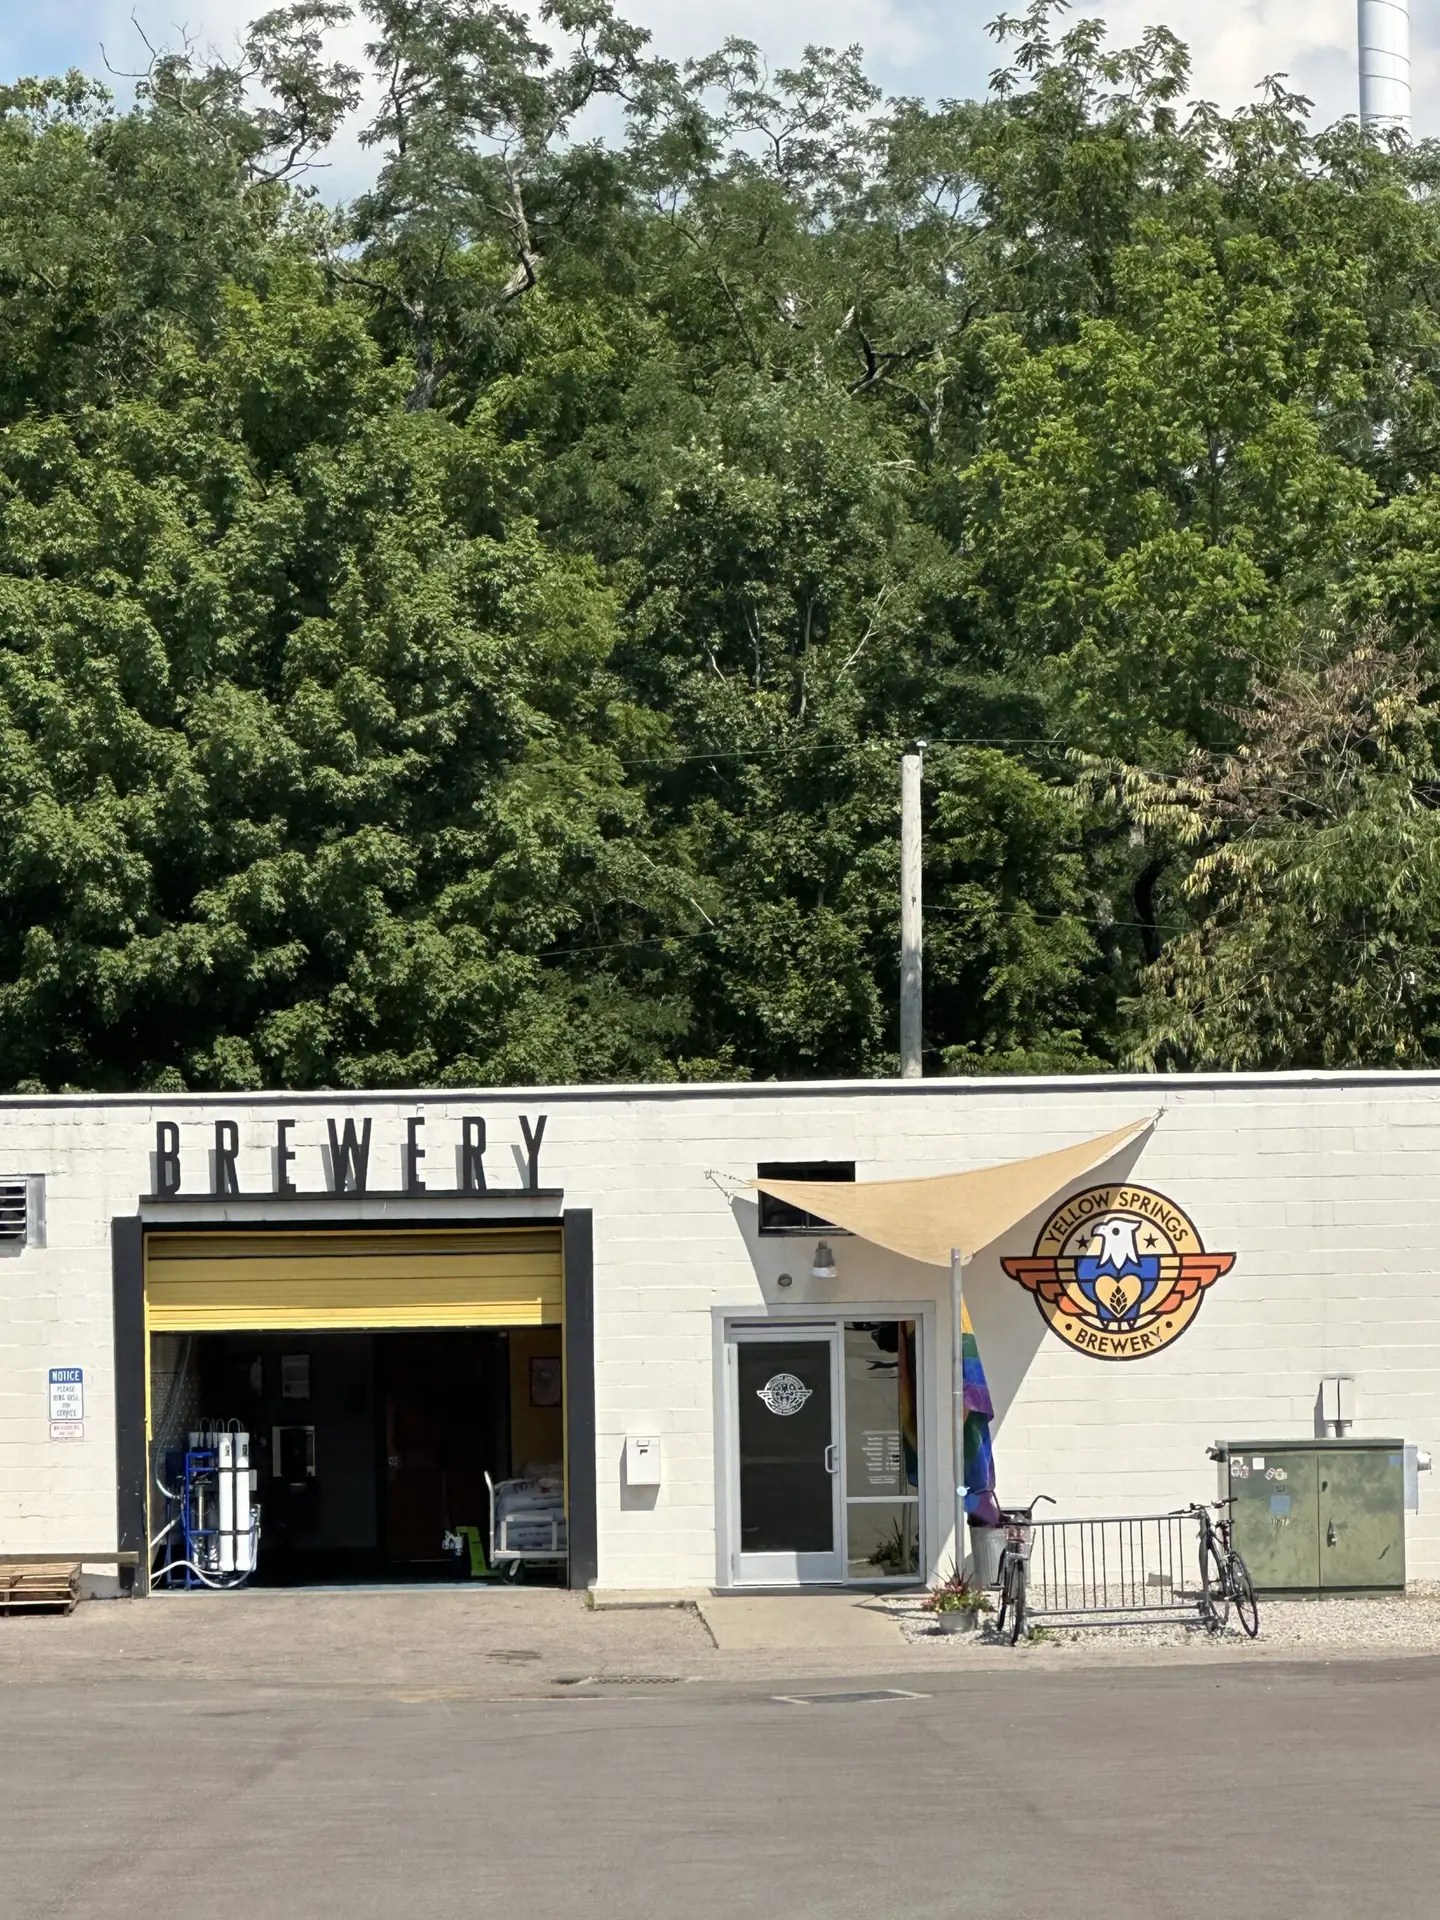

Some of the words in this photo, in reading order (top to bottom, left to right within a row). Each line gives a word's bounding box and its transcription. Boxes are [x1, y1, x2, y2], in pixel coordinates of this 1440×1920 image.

[156, 1115, 548, 1195] BREWERY
[1044, 1191, 1110, 1244] YELLOW
[1118, 1191, 1189, 1243] SPRINGS
[1074, 1326, 1163, 1354] BREWERY
[52, 1370, 80, 1382] NOTICE
